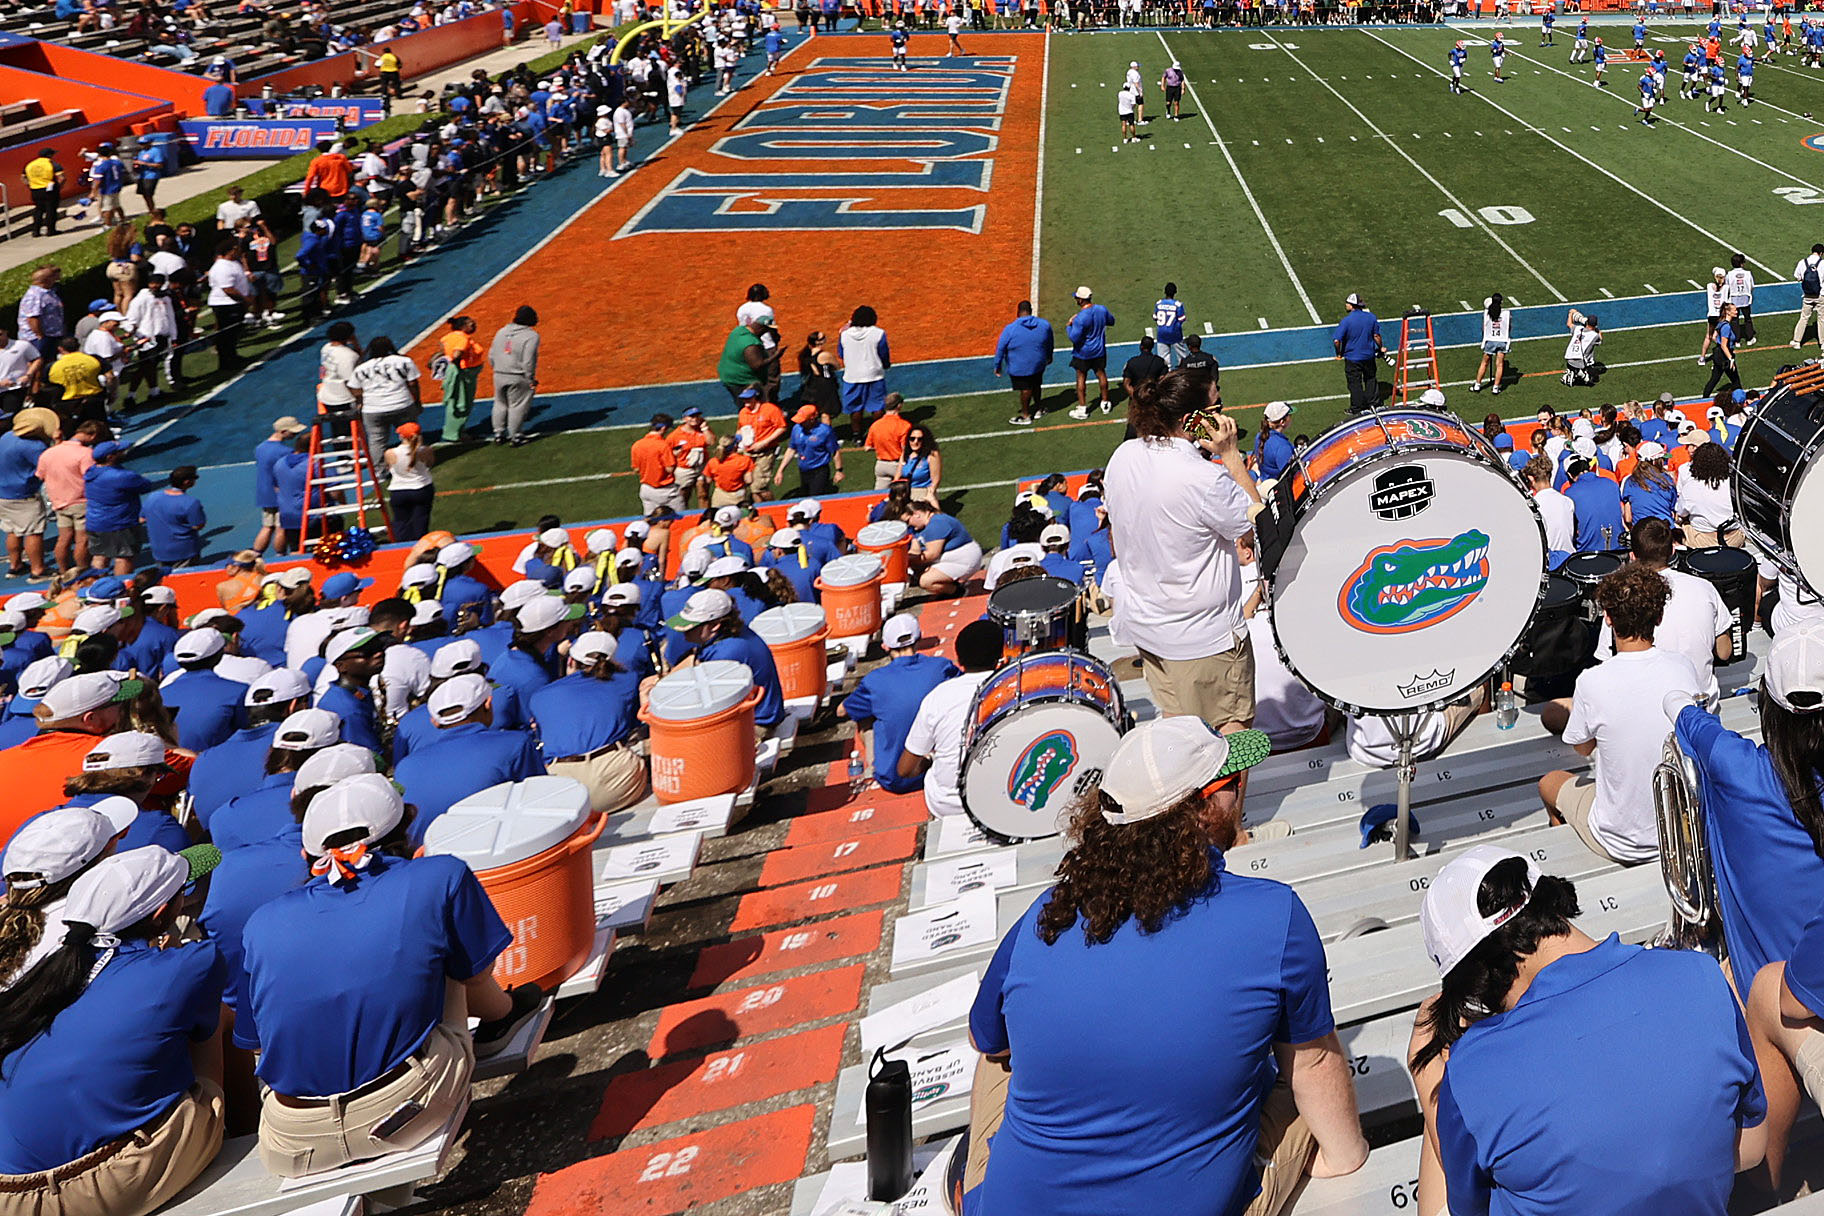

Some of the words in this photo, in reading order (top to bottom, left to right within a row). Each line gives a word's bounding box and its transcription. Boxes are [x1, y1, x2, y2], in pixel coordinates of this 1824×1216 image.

[203, 127, 312, 149] FLORIDA
[1437, 205, 1537, 227] 10
[1157, 310, 1176, 326] 97
[1187, 360, 1206, 369] POLICE
[1375, 484, 1429, 506] MAPEX
[1730, 606, 1742, 624] VIC
[1732, 625, 1743, 656] FIRTH
[1406, 676, 1449, 696] REMO
[1337, 790, 1354, 802] 30
[1478, 808, 1495, 821] 31
[1599, 896, 1618, 912] 31
[736, 986, 785, 1015] 20
[703, 1052, 745, 1082] 21
[946, 1058, 961, 1068] UF
[911, 1067, 964, 1087] RESERVE
[638, 1144, 700, 1184] 22
